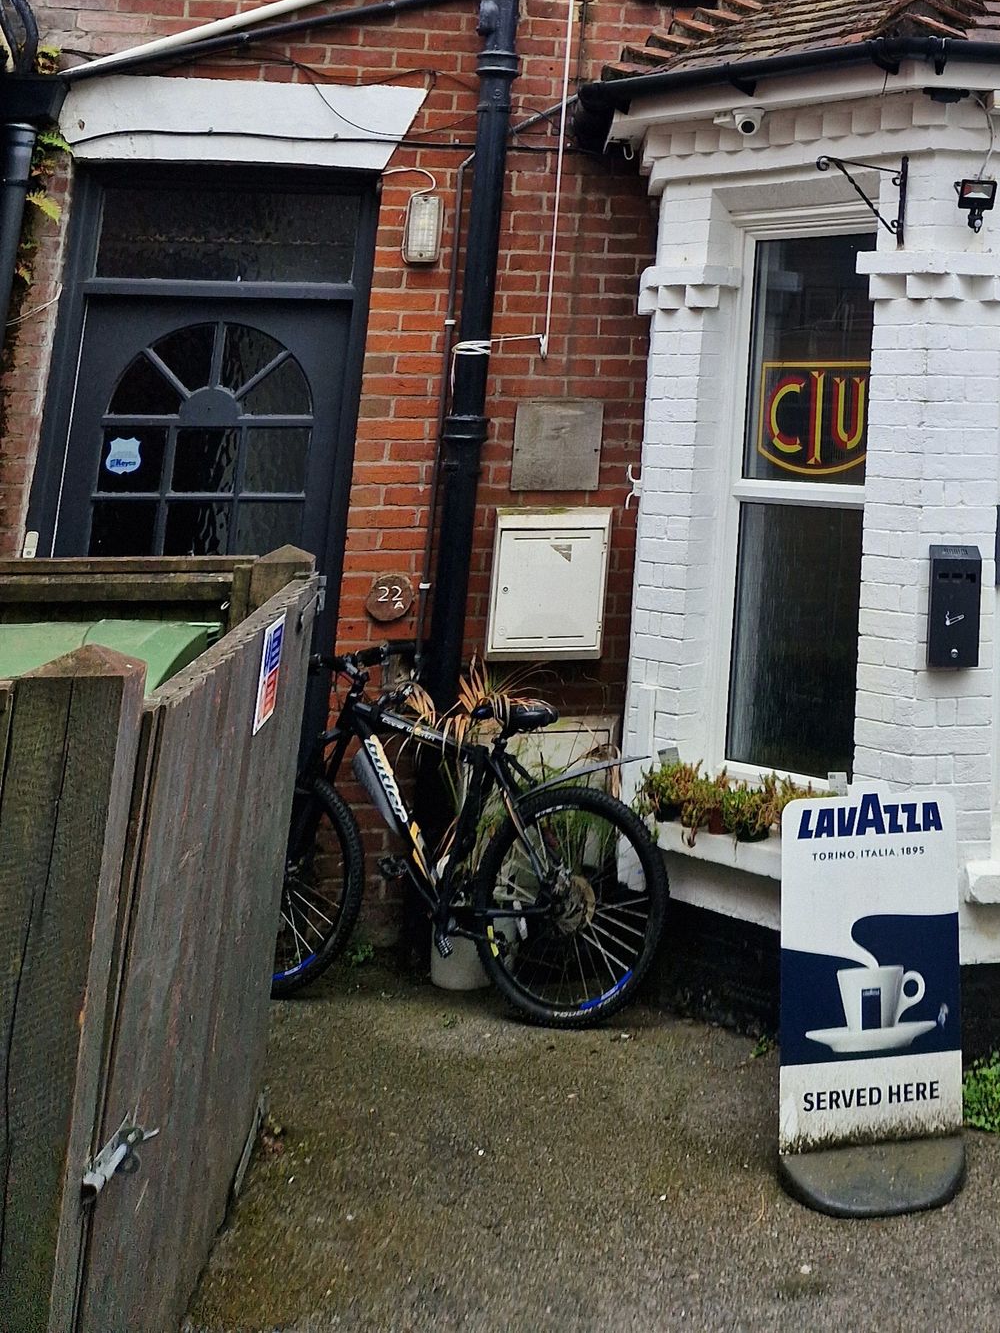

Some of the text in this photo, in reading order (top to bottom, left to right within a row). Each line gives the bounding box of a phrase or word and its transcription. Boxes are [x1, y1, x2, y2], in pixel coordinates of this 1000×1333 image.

[767, 370, 866, 465] CIU
[378, 585, 403, 602] 22
[394, 601, 404, 610] A
[797, 793, 943, 840] LAVAZZA
[901, 846, 925, 856] 1895
[803, 1080, 940, 1112] SERVED HERE
